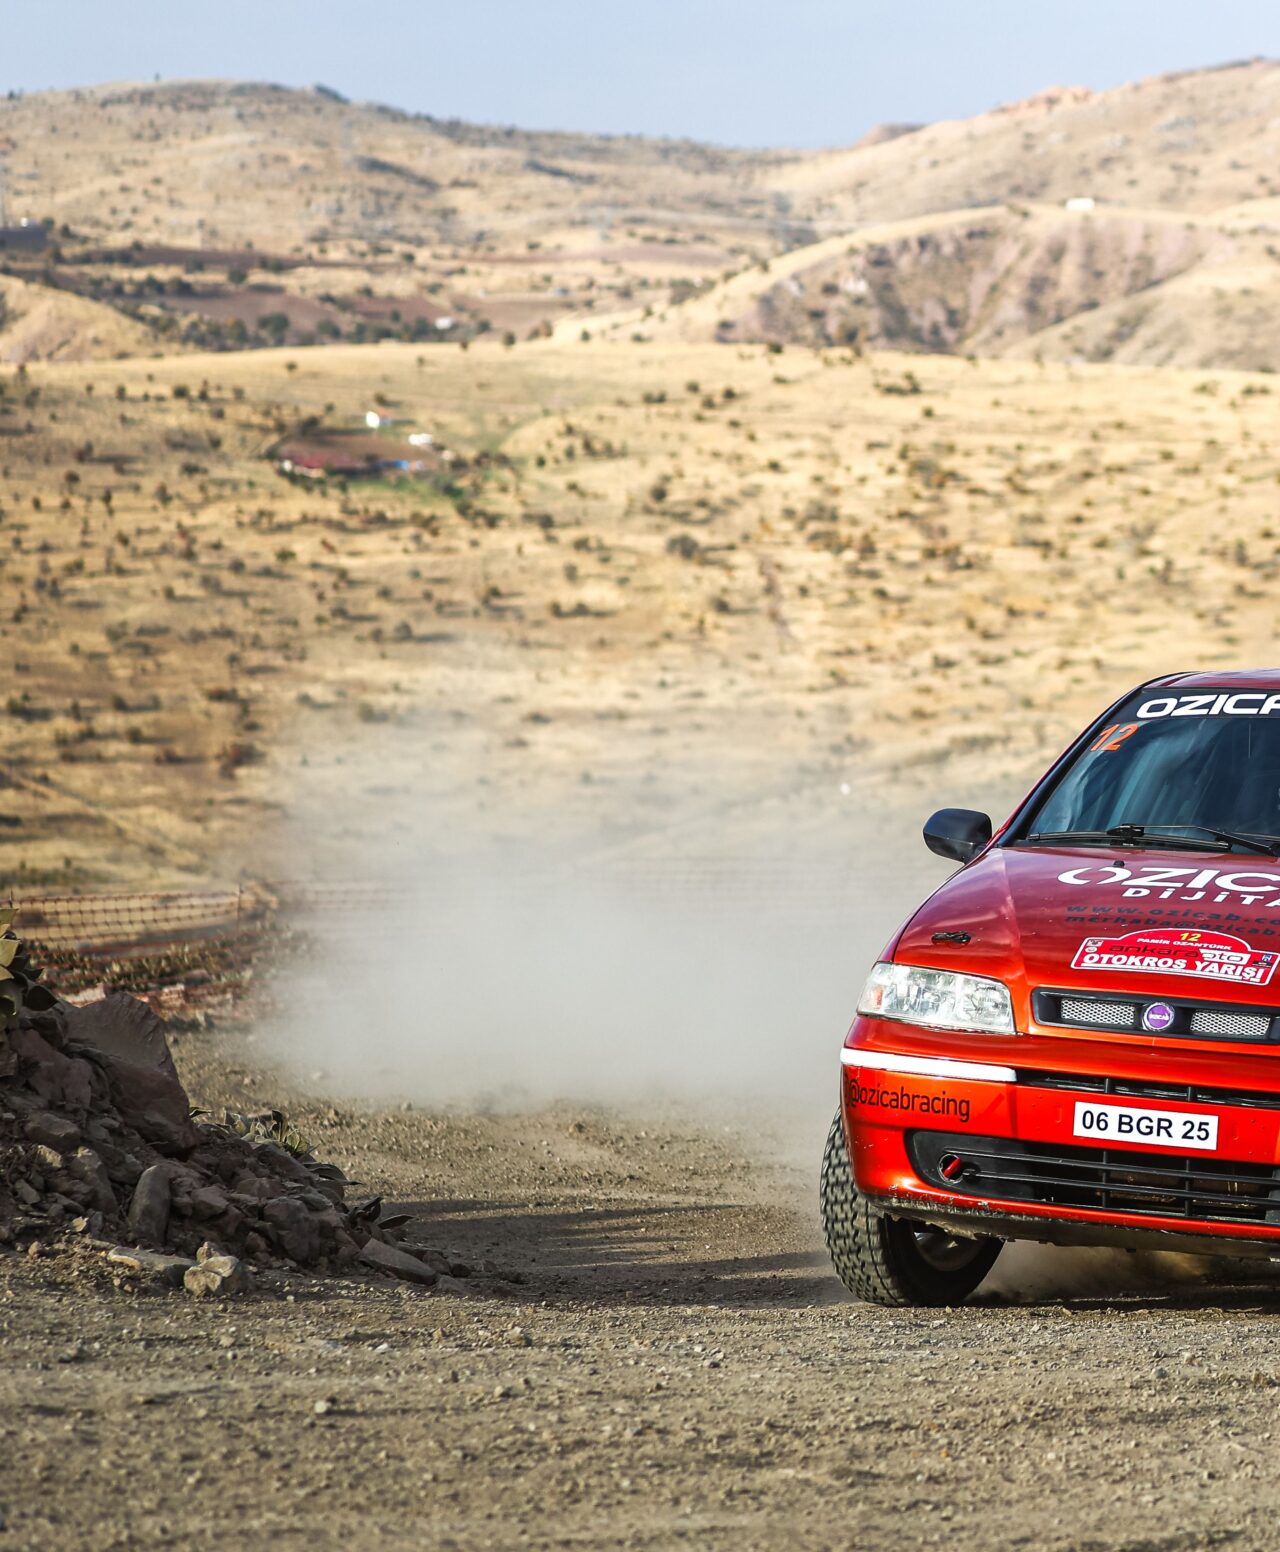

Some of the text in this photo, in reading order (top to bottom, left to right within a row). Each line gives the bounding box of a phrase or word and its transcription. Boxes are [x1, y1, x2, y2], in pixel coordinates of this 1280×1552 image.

[1090, 723, 1140, 752] 12
[1180, 932, 1202, 942] 12
[1083, 953, 1265, 981] OTOKROS YARIŞI
[848, 1079, 971, 1123] @ozicabracing
[1082, 1110, 1210, 1141] 06 BGR 25
